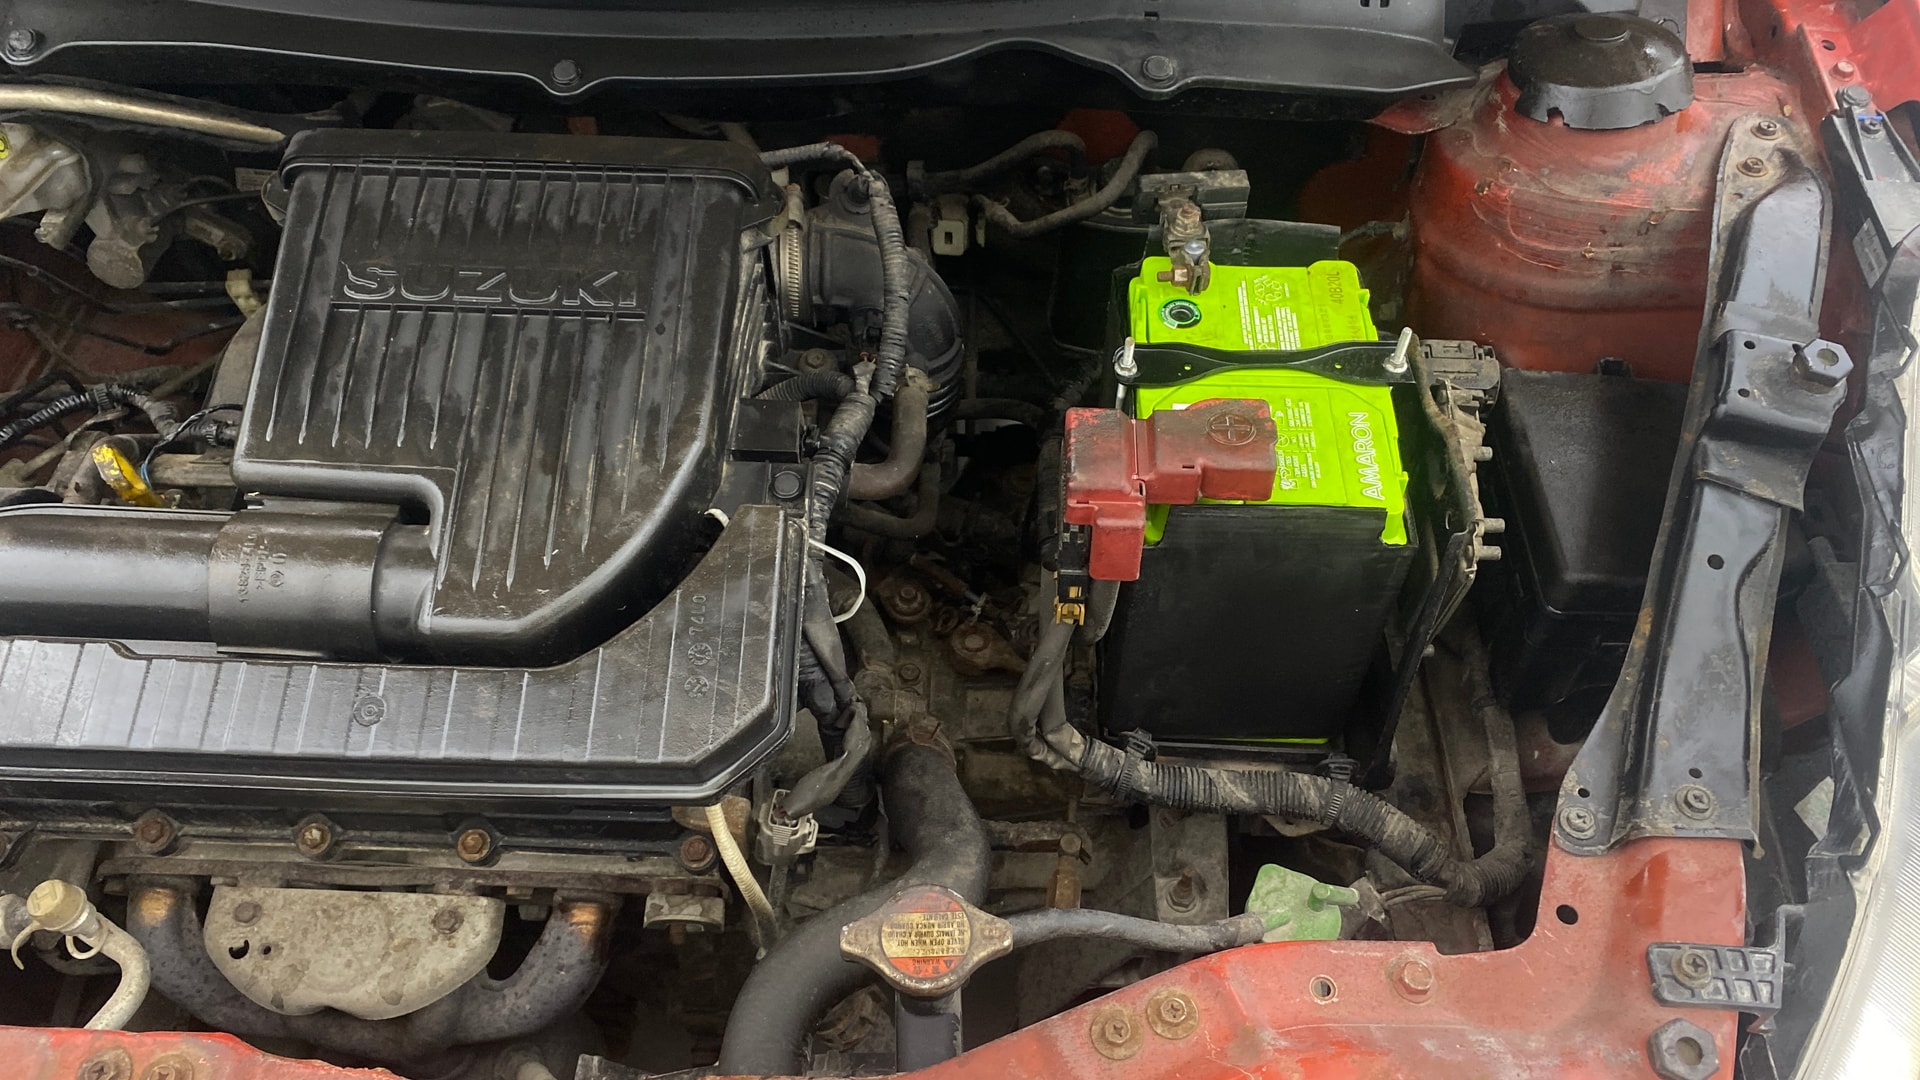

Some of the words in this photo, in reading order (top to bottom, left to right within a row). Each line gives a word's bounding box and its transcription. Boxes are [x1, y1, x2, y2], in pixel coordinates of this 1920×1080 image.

[342, 261, 637, 307] SUZUKI
[1325, 271, 1345, 304] 40B20L
[1347, 412, 1385, 501] AMARON
